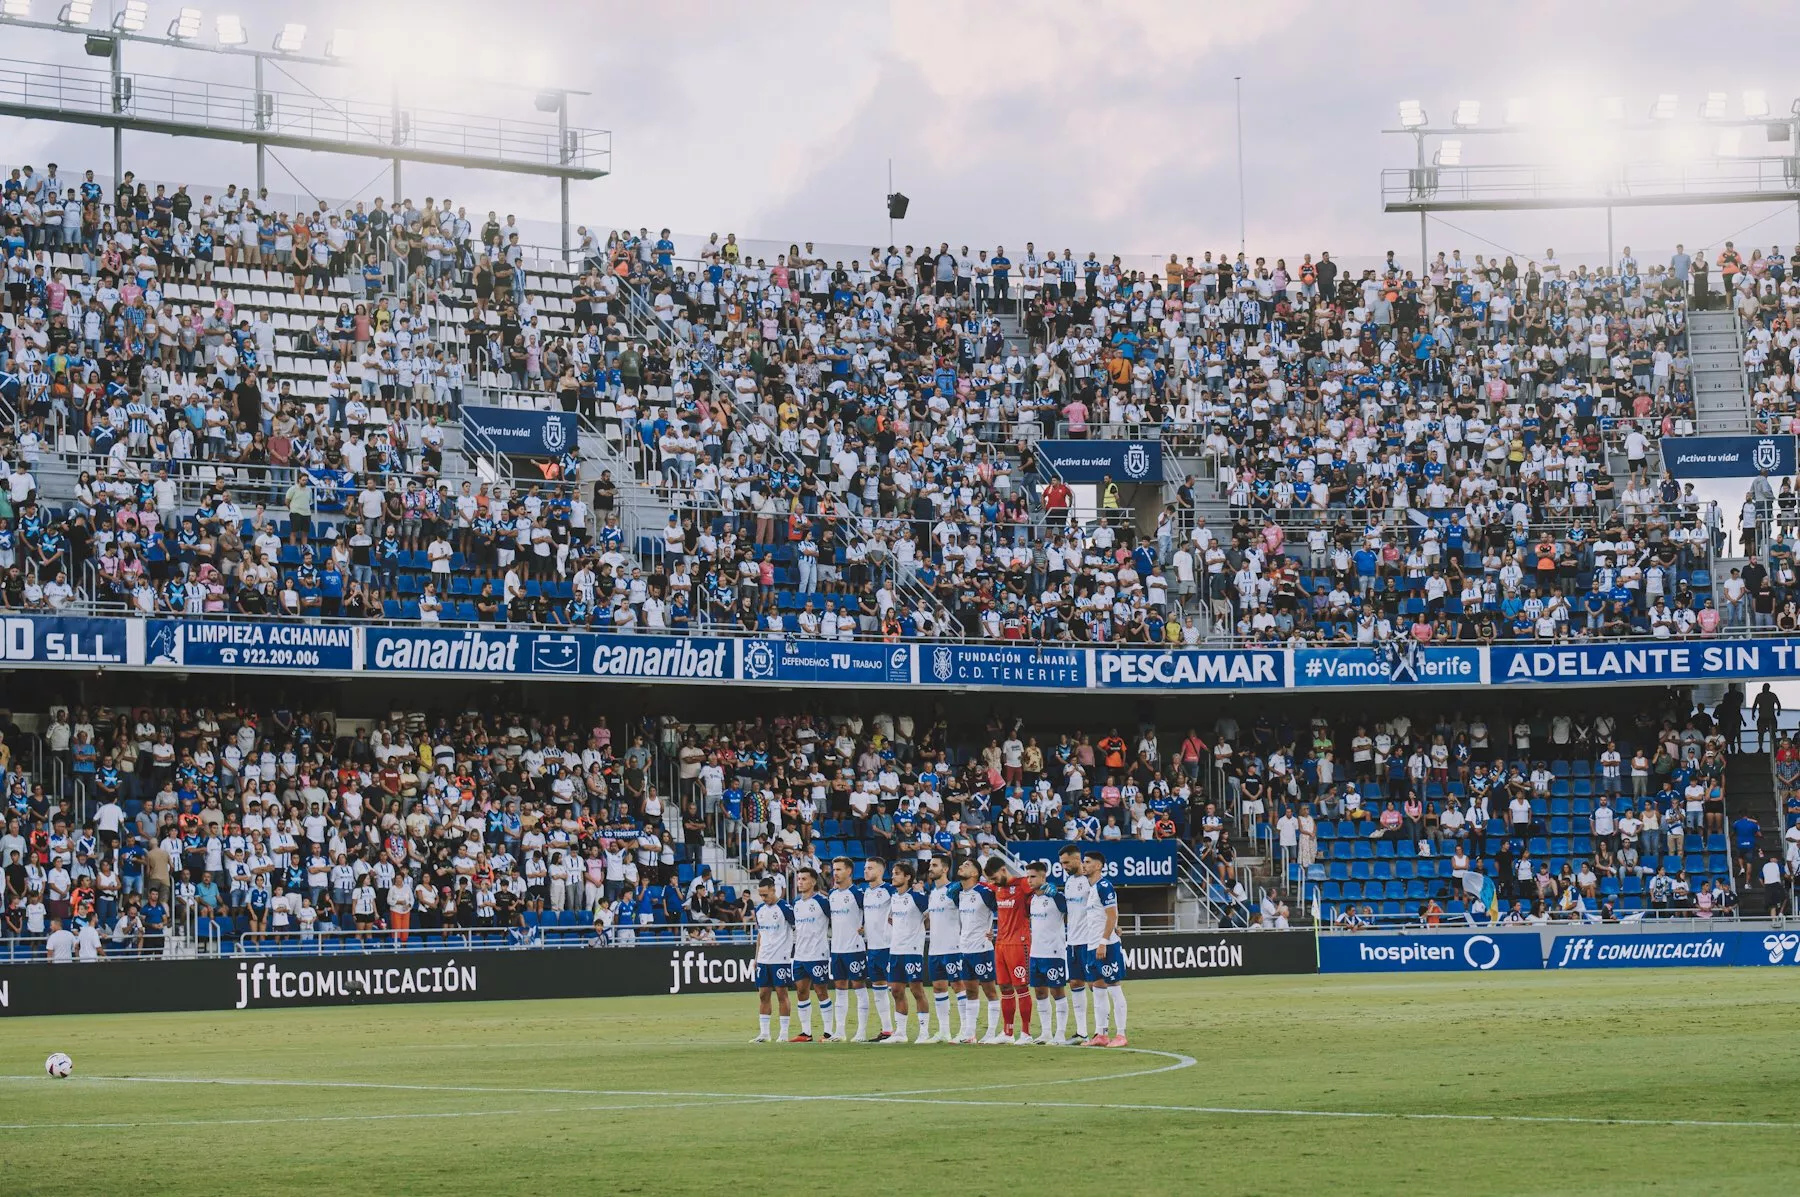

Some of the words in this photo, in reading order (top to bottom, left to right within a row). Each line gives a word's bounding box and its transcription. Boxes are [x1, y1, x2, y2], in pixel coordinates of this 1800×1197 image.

[503, 428, 511, 436] tu
[511, 428, 531, 437] vida!
[1091, 457, 1112, 466] vida!
[1677, 454, 1706, 464] ¡Activa
[1717, 453, 1739, 462] vida!
[0, 617, 34, 660] D
[45, 632, 121, 661] S.L.L.
[188, 624, 264, 645] LIMPIEZA
[268, 626, 350, 647] ACHAMAN
[242, 648, 319, 665] 922.209.006
[375, 632, 519, 671] canaribat
[592, 639, 726, 677] canaribat
[782, 656, 830, 668] DEFENDEMOS
[831, 653, 850, 670] TU
[852, 660, 882, 669] TRABAJO
[958, 651, 1021, 664] FUNDACIÓN
[1028, 654, 1078, 666] CANARIA
[1507, 649, 1690, 677] ADELANTE
[1702, 646, 1759, 671] SIN
[992, 666, 1078, 682] TENERIFE
[1101, 654, 1277, 683] PESCAMAR
[1123, 855, 1172, 876] Salud
[1359, 942, 1455, 965] hospiten
[1559, 938, 1594, 967] jft
[1597, 938, 1725, 960] COMUNICACIÓN
